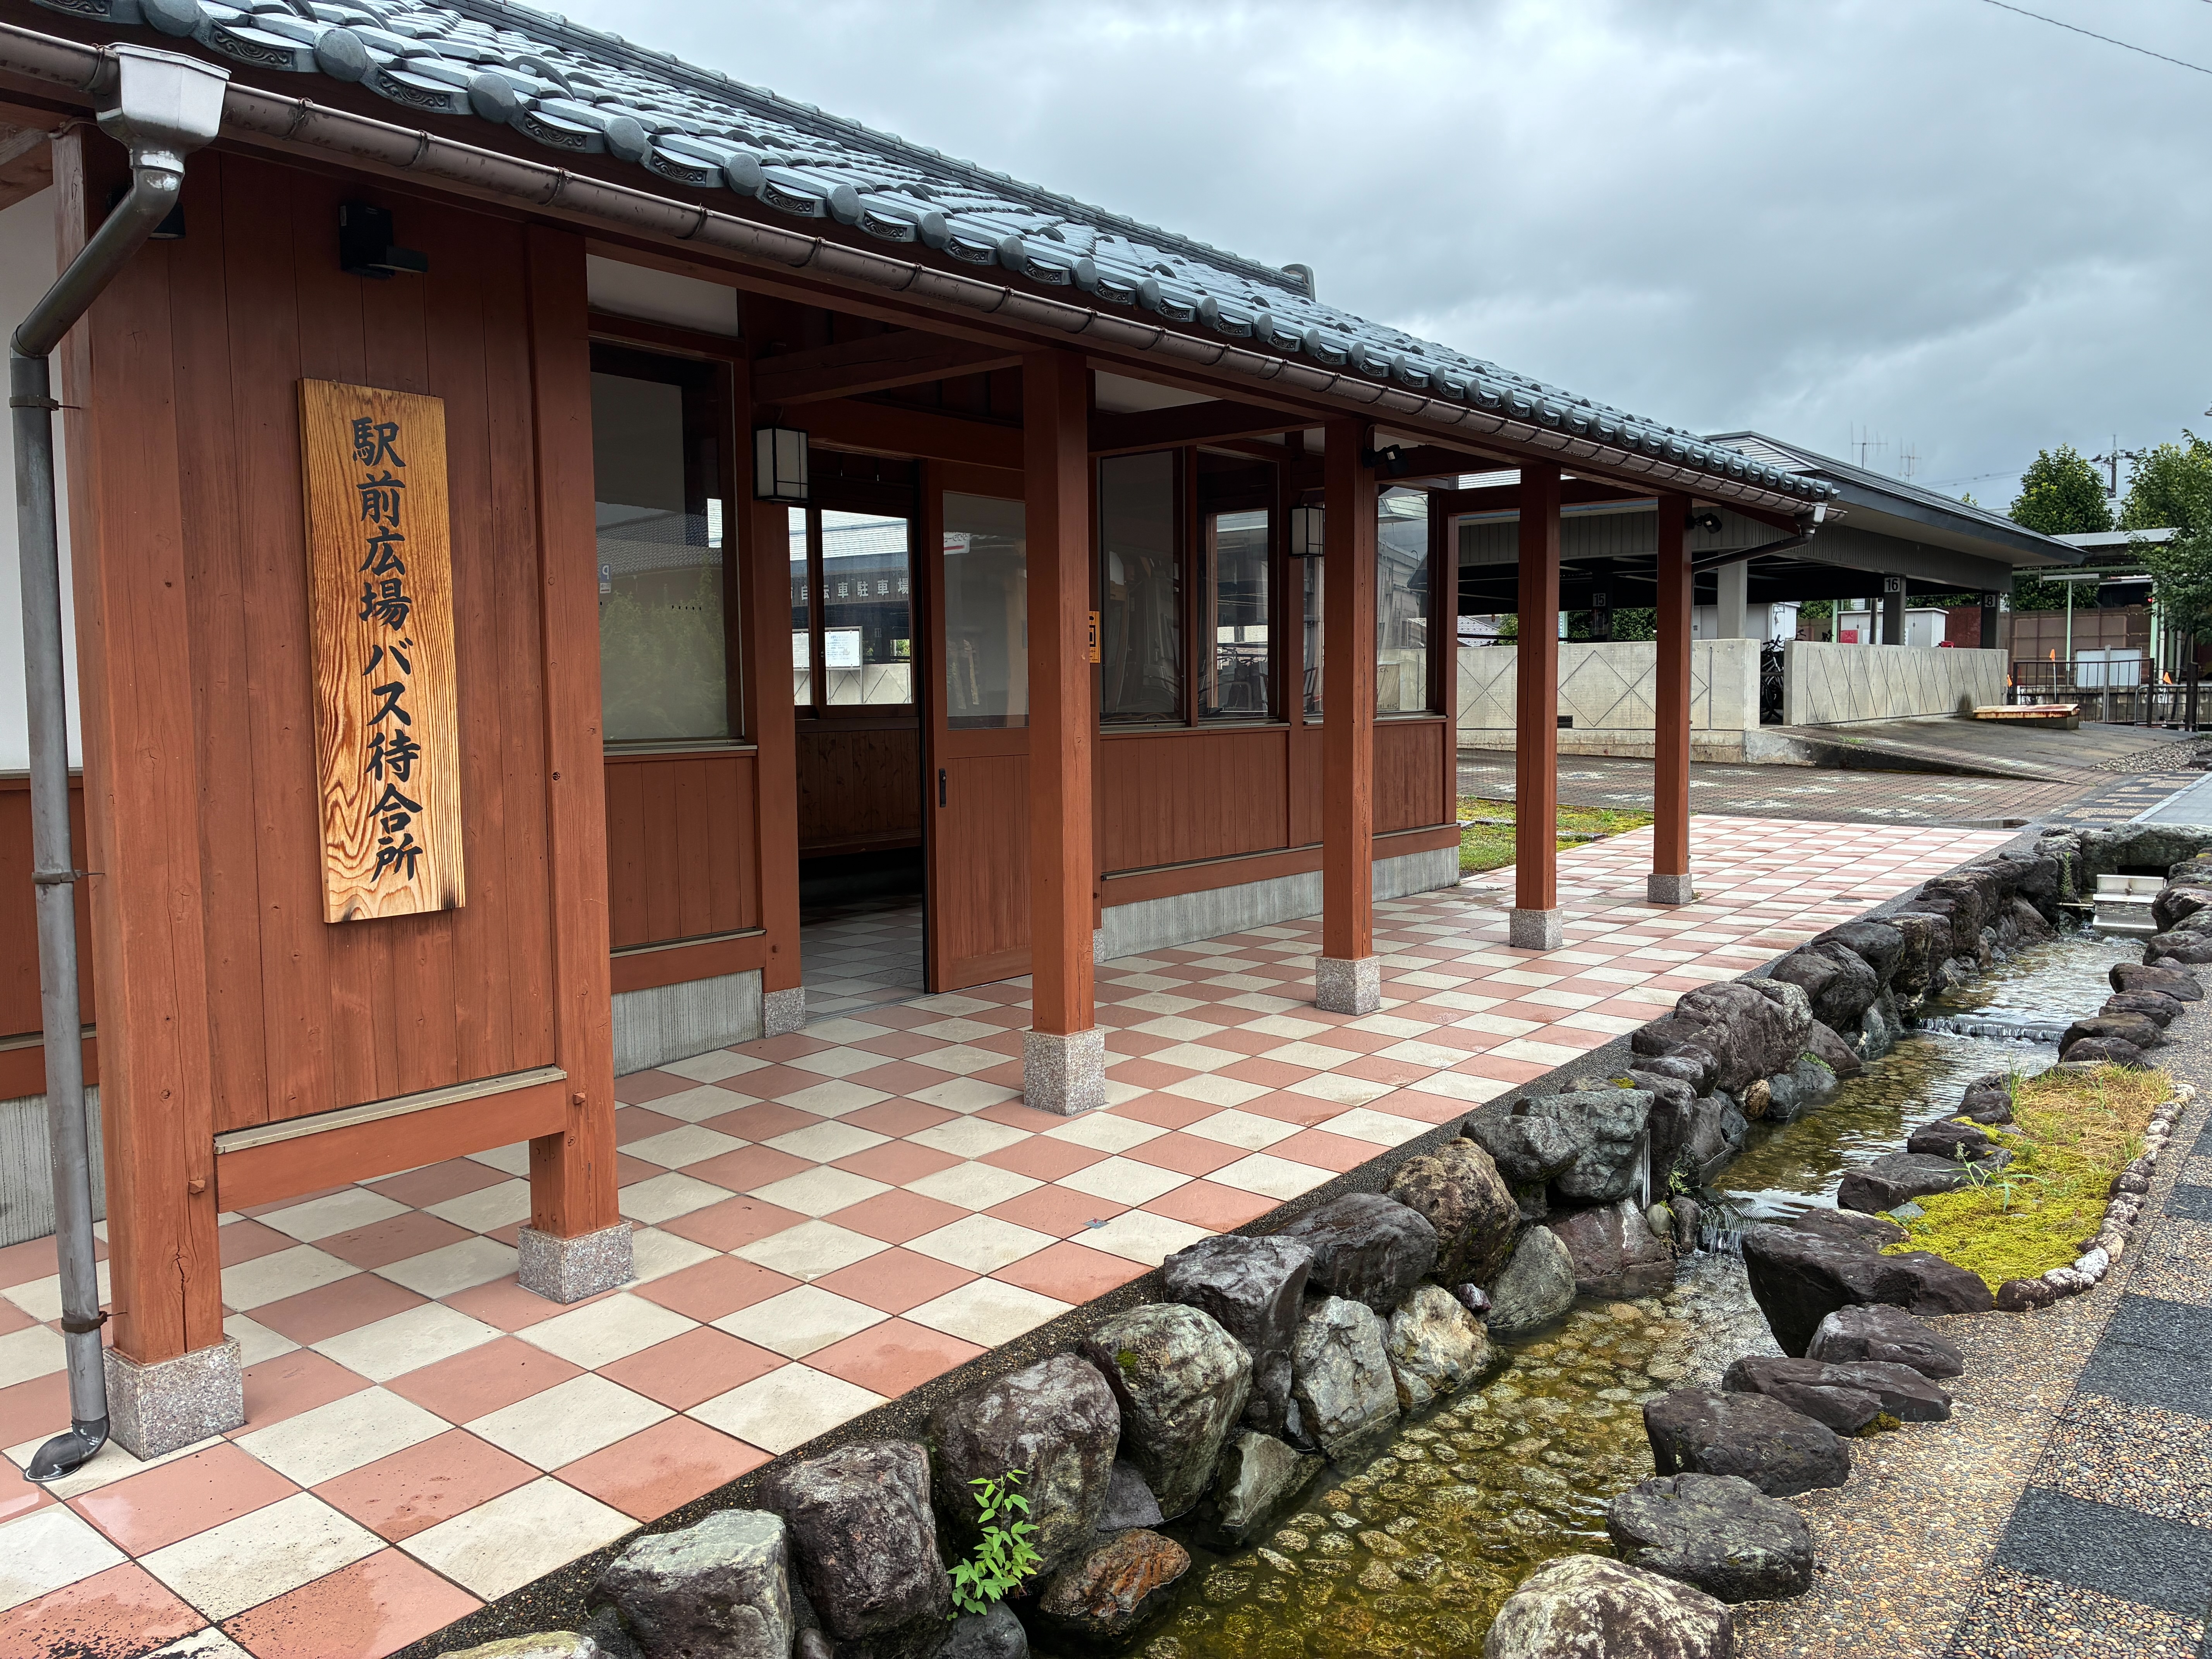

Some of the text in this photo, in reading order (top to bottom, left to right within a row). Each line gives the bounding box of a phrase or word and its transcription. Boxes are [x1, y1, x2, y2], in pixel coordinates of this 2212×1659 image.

[791, 578, 908, 600] 自車駐車場
[1886, 579, 1898, 591] 16
[1594, 594, 1604, 605] 15
[1987, 596, 1993, 606] 8
[351, 417, 423, 883] 駅前広場バス待合所
